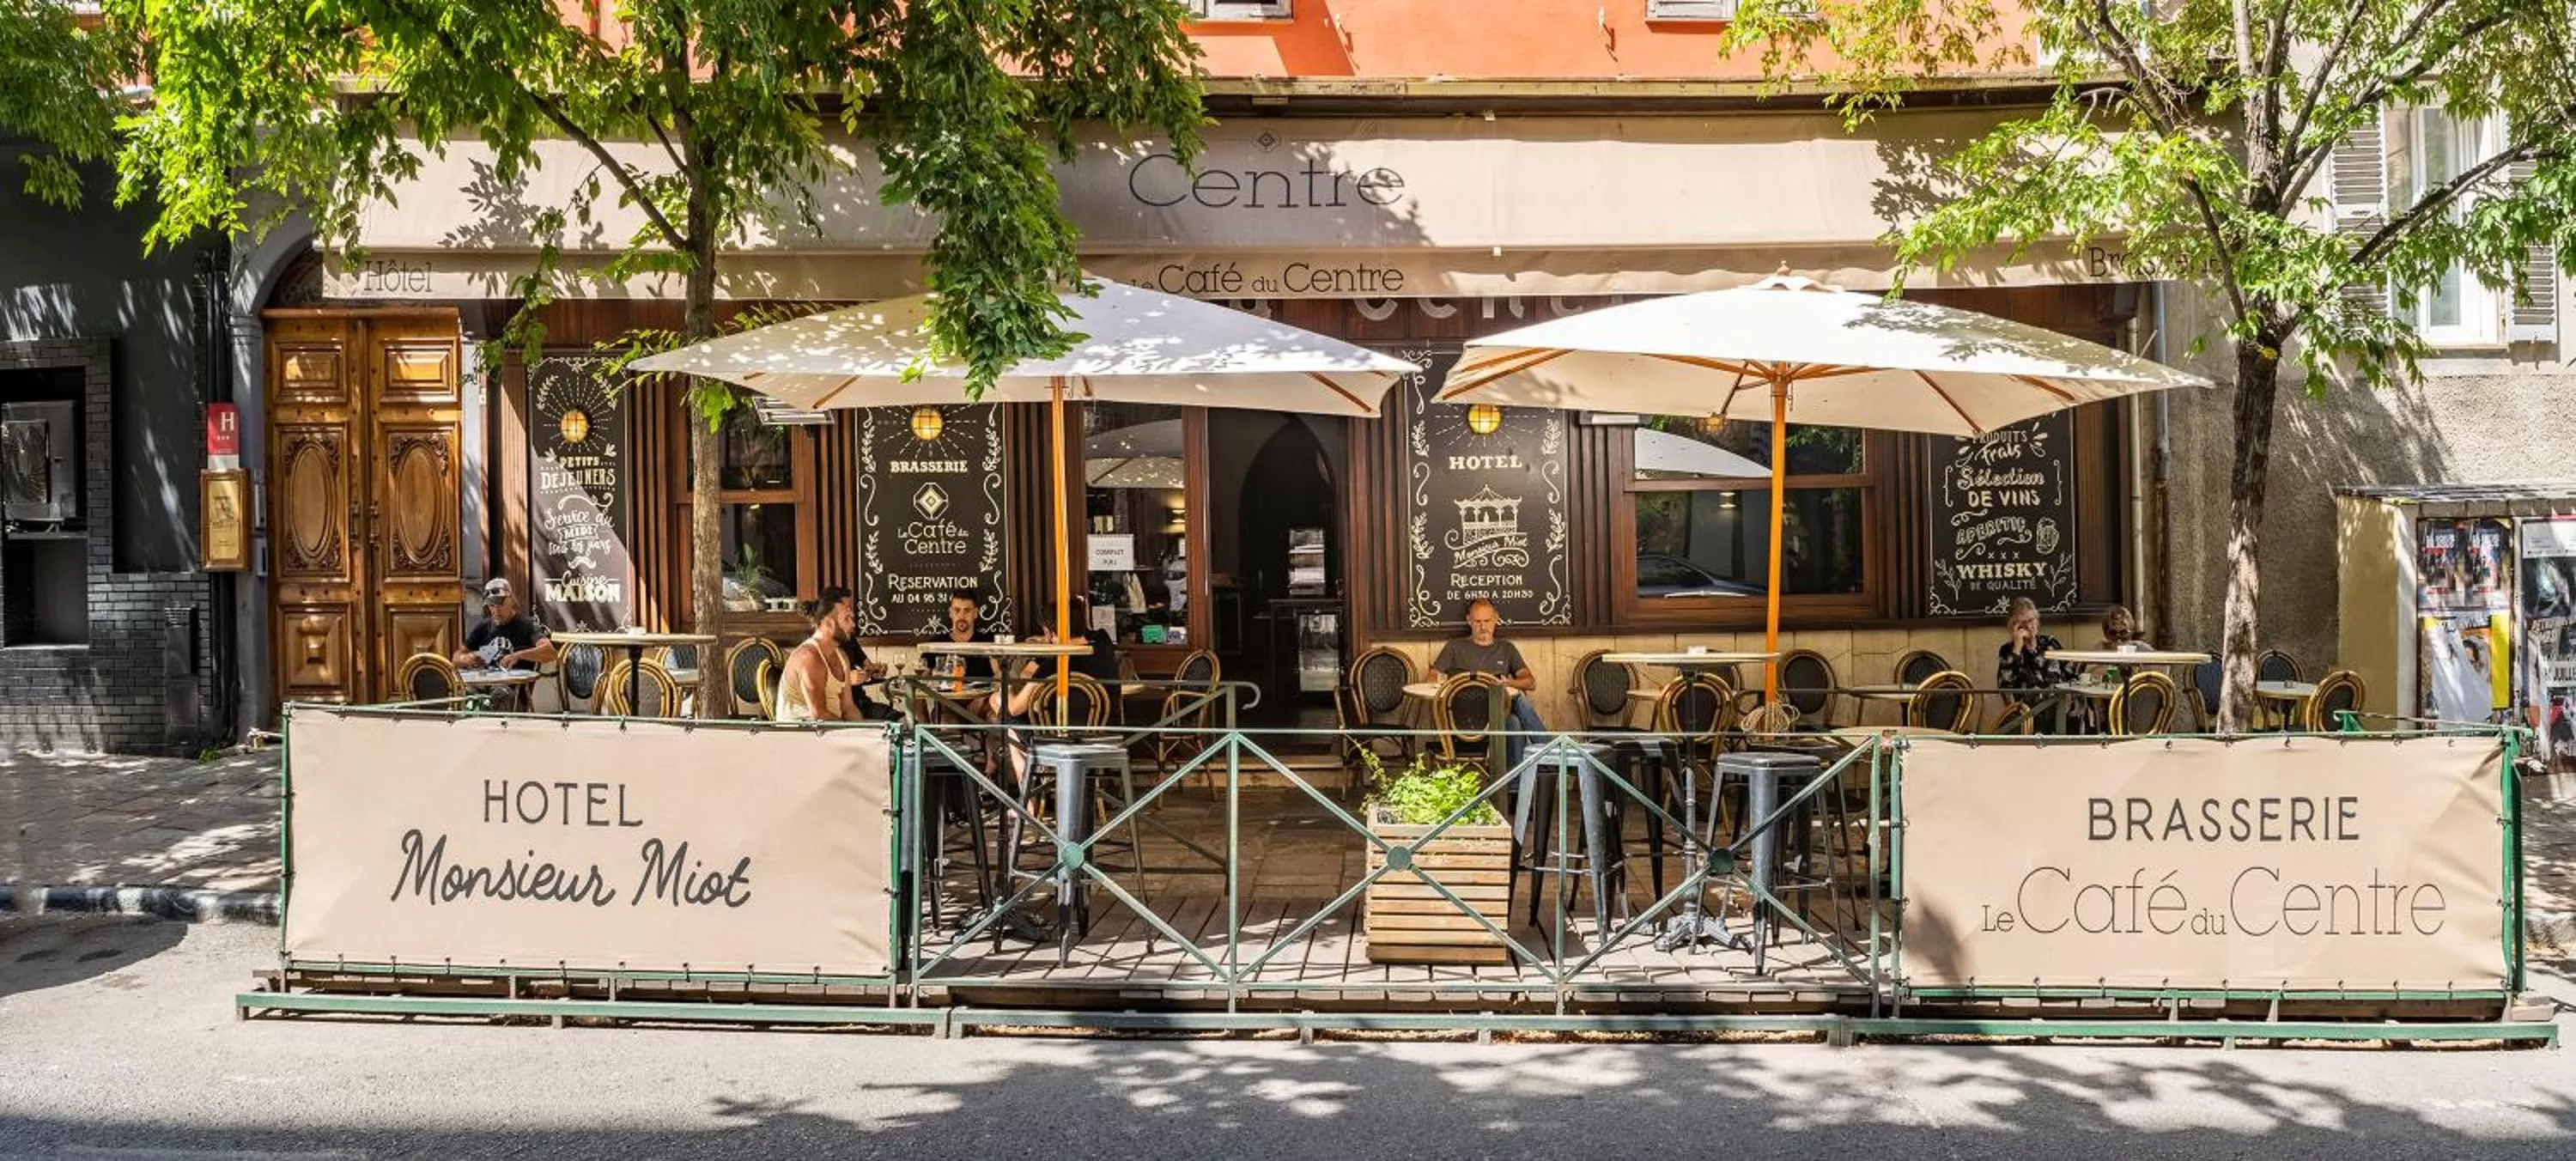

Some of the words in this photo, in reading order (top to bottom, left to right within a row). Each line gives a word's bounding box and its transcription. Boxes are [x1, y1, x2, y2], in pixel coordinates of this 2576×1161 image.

[1129, 154, 1405, 208] Centre
[363, 258, 433, 293] Hôtel
[1158, 262, 1242, 294] Café
[1251, 277, 1279, 293] du
[1284, 262, 1404, 294] Centre
[221, 411, 234, 431] H
[559, 456, 600, 469] PETITS
[890, 460, 968, 473] BRASSERIE
[1449, 455, 1522, 470] HOTEL
[542, 468, 616, 489] DEJEUNERS
[1957, 465, 2046, 489] Sélection
[1968, 490, 1993, 508] DE
[1999, 489, 2041, 508] VINS
[544, 508, 591, 530] Service
[595, 509, 616, 527] du
[897, 528, 908, 538] Le
[908, 519, 957, 538] Café
[564, 526, 593, 538] MIDI
[904, 538, 967, 555] Centre
[561, 569, 609, 587] Cuisine
[1956, 562, 2048, 580] WHISKY
[888, 573, 978, 592] RESERVATION
[1450, 574, 1523, 588] RECEPTION
[1987, 577, 2037, 591] QUALITÉ
[544, 585, 622, 602] MAISON
[891, 593, 904, 604] AU
[908, 593, 920, 603] 04
[1447, 591, 1461, 600] DE
[1492, 590, 1498, 599] A
[483, 779, 643, 827] HOTEL
[2087, 796, 2360, 842] BRASSERIE
[391, 829, 617, 907] Monsieur
[631, 837, 751, 908] Miot
[1981, 904, 2014, 932] Le
[2017, 866, 2187, 933] Café
[2190, 908, 2227, 935] du
[2230, 866, 2446, 936] Centre
